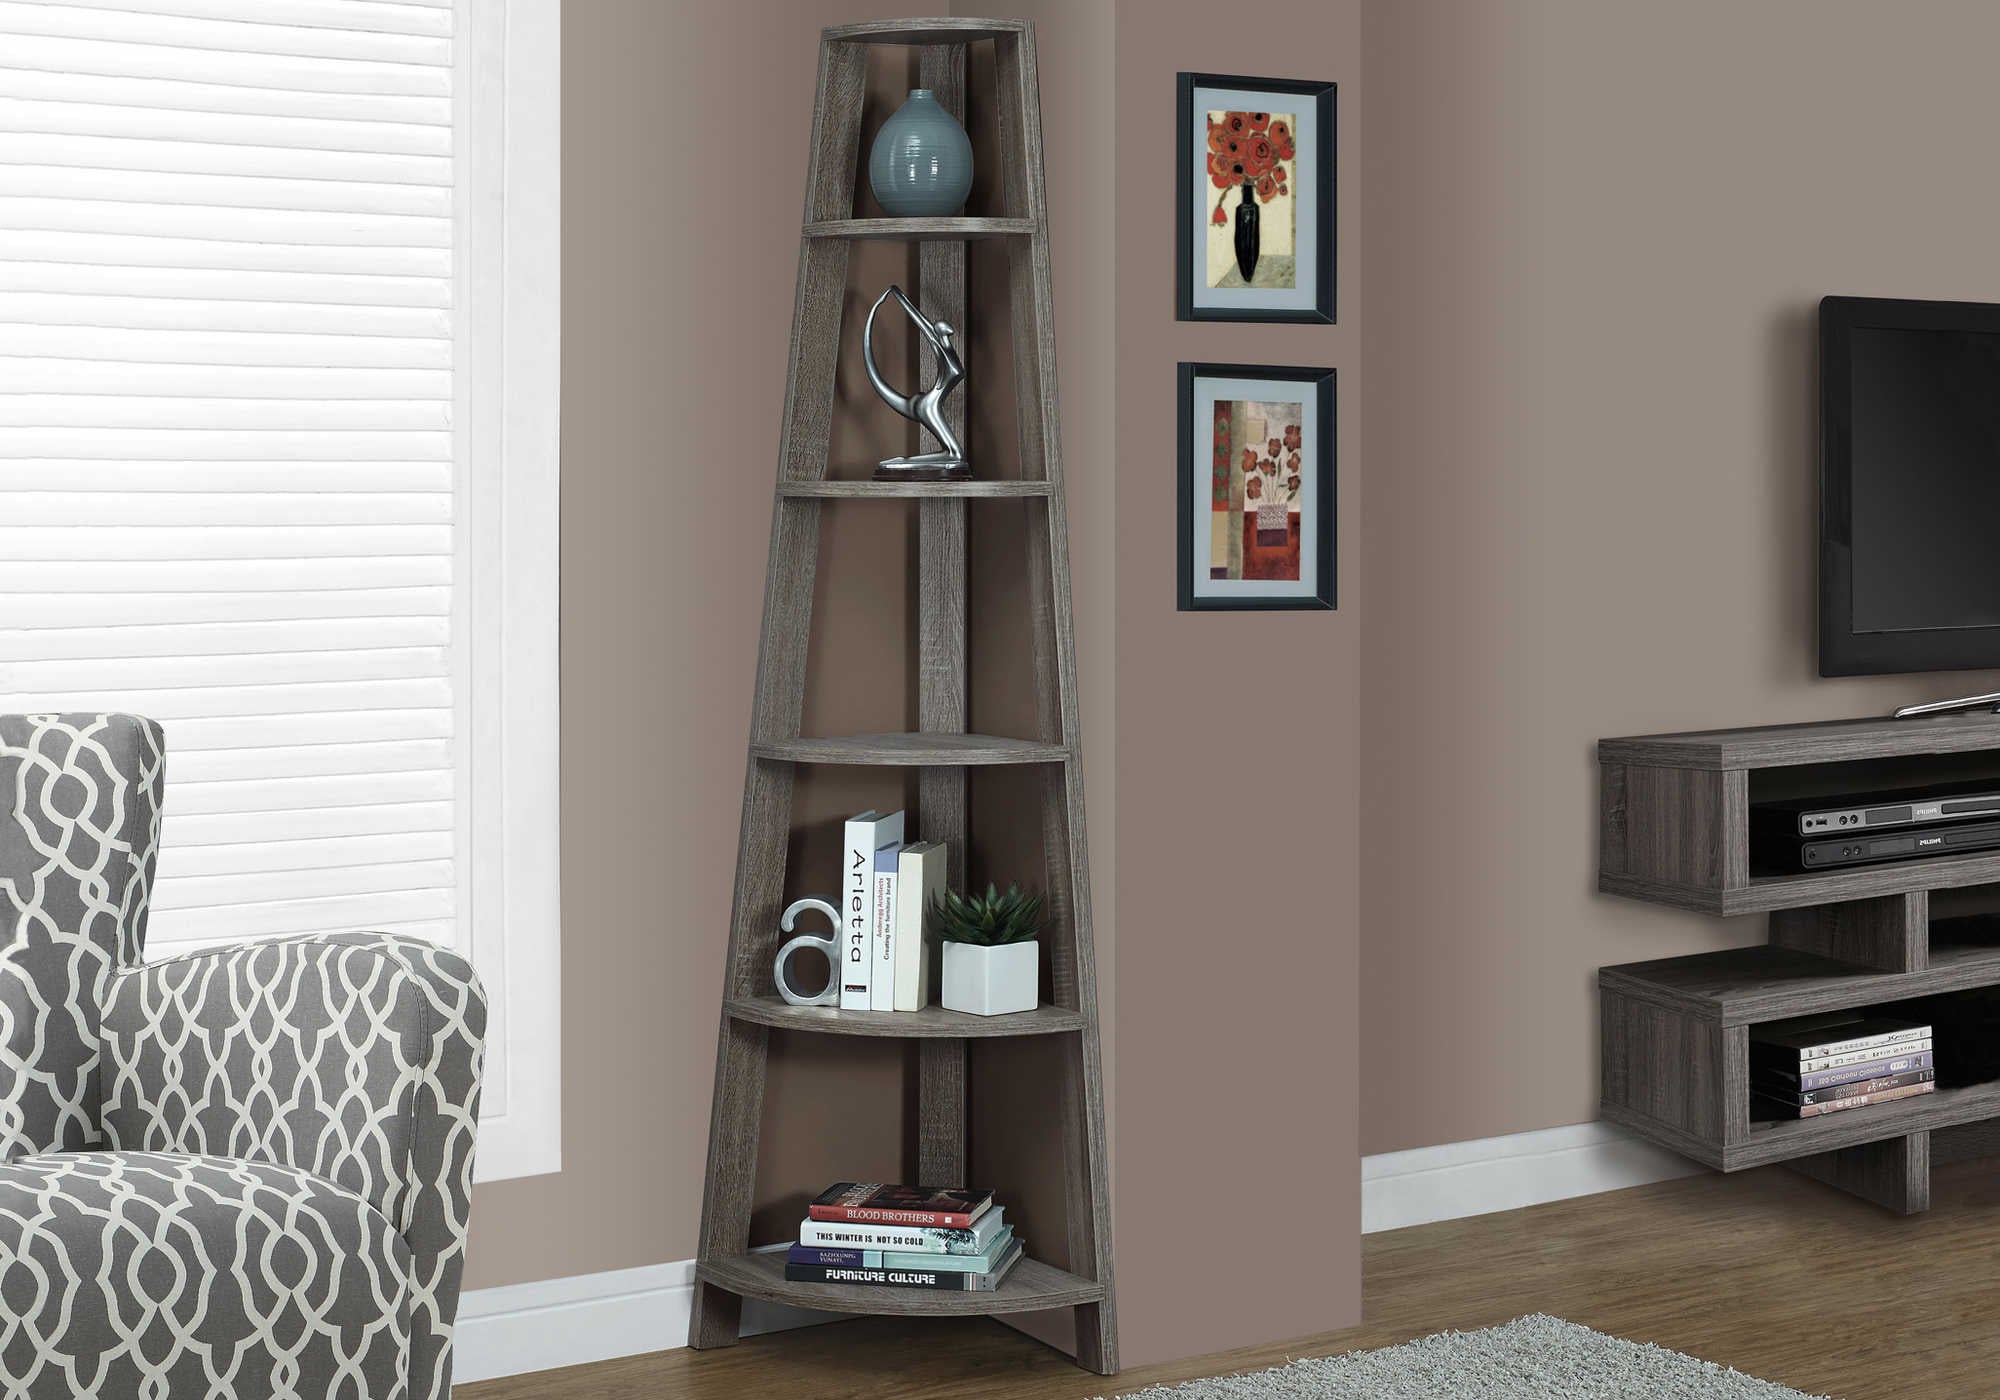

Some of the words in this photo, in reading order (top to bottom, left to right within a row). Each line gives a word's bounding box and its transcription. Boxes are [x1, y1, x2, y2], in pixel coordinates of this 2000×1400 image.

[851, 849, 866, 962] Arletta
[883, 934, 891, 960] Creating
[847, 1209, 880, 1220] BLOOD
[882, 1211, 935, 1224] BROTHERS
[816, 1232, 833, 1241] THIS
[835, 1233, 863, 1243] WINTER
[865, 1235, 872, 1243] IS
[877, 1236, 891, 1244] NOT
[893, 1236, 903, 1245] SO
[904, 1237, 924, 1246] COLD
[826, 1269, 885, 1281] FURNITURE
[888, 1272, 936, 1285] CULTURE
